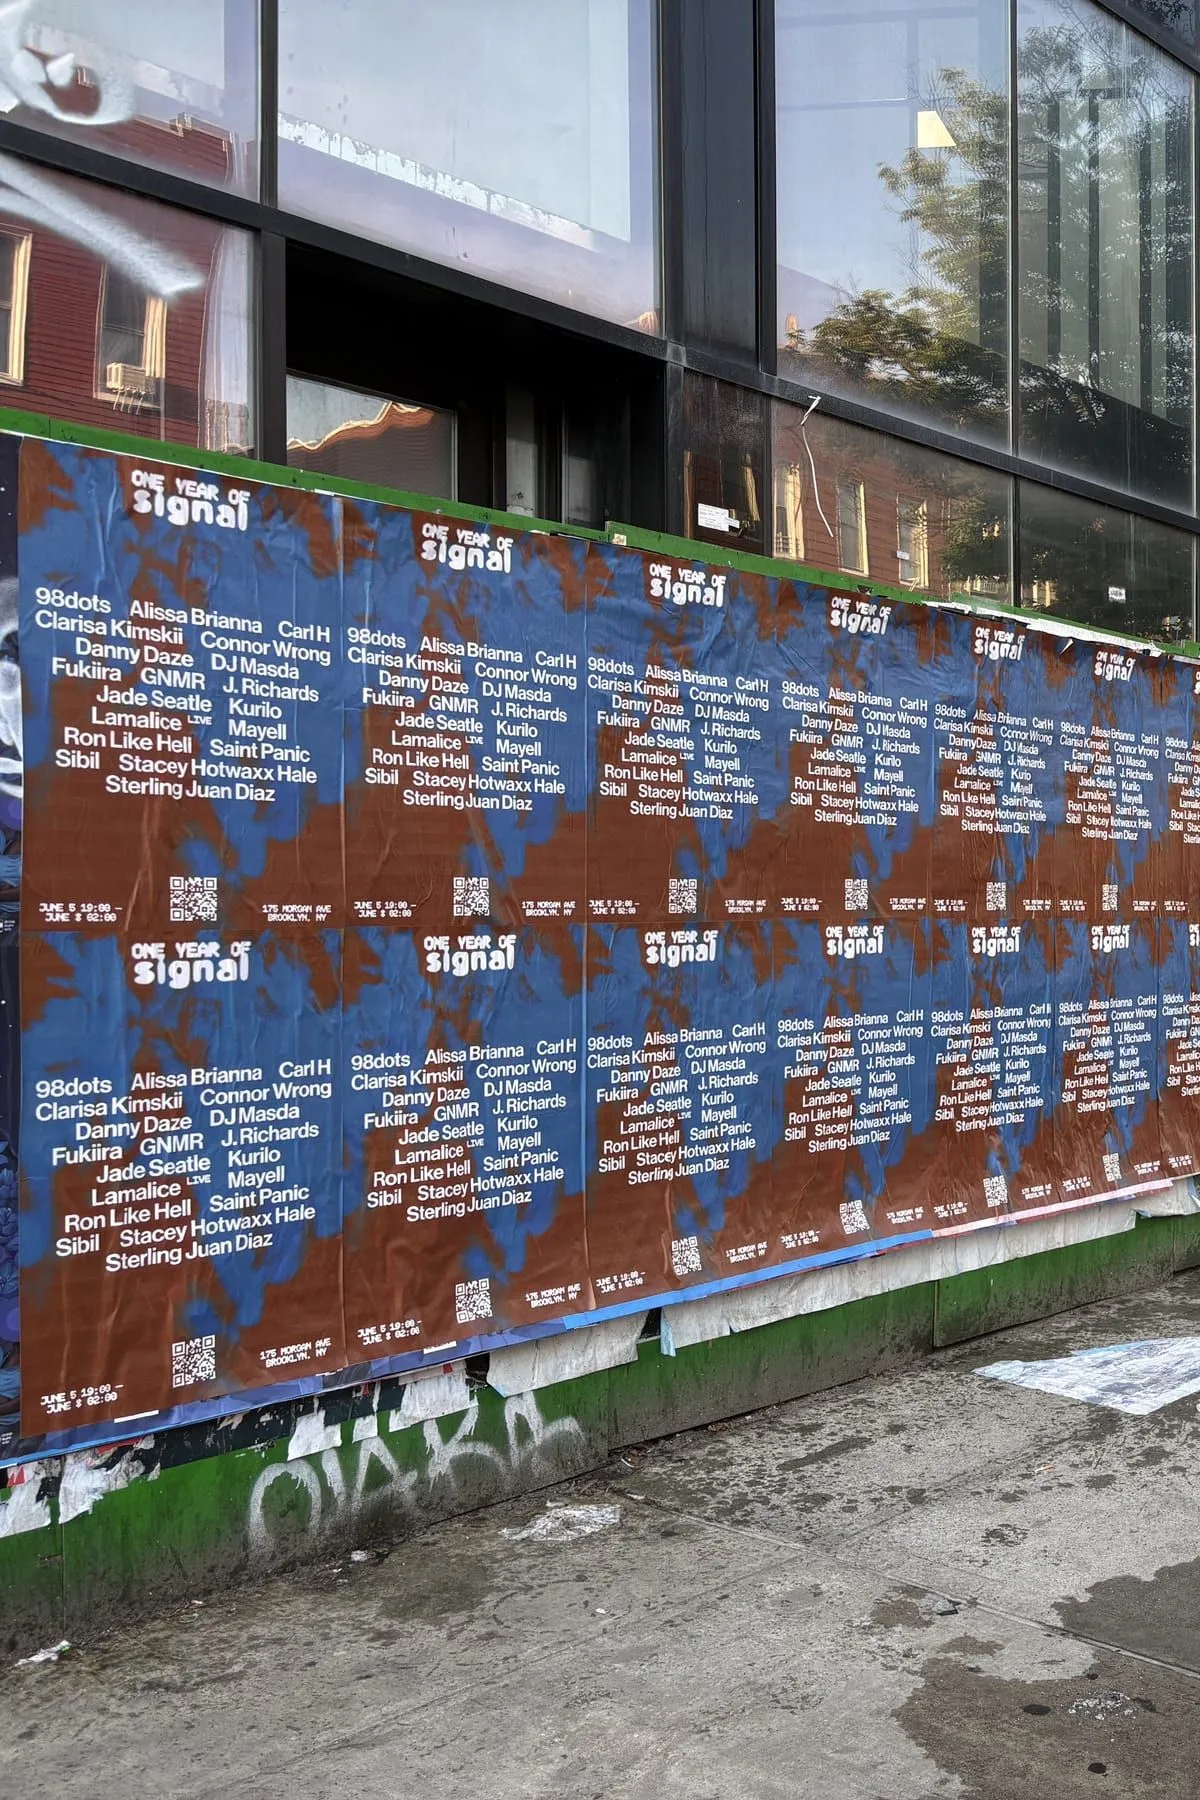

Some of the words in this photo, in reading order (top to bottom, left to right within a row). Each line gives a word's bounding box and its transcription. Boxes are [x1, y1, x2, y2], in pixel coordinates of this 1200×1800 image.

[131, 470, 165, 491] ONE
[175, 477, 219, 501] YEAR
[228, 489, 250, 505] OF
[133, 489, 248, 531] signal
[422, 522, 449, 540] ONE
[456, 528, 490, 548] YEAR
[496, 536, 513, 550] OF
[421, 539, 511, 573] signal
[35, 587, 111, 613] 98dots
[130, 600, 188, 624] Alissa
[191, 608, 262, 633] Brianna
[278, 621, 314, 640] Carl
[317, 626, 330, 643] H
[830, 608, 888, 635] signal
[831, 596, 849, 610] ONE
[855, 600, 876, 614] YEAR
[879, 606, 892, 617] OF
[35, 610, 107, 635] Clarisa
[111, 619, 183, 644] Kimskii
[201, 631, 271, 655] Connor
[272, 640, 330, 666] Wrong
[76, 637, 140, 664] Danny
[144, 645, 194, 667] Daze
[211, 653, 237, 672] DJ
[241, 657, 299, 679] Masda
[348, 647, 403, 668] Clarisa
[406, 653, 461, 674] Kimskii
[475, 662, 529, 681] Connor
[531, 668, 577, 690] Wrong
[52, 657, 121, 681] Fukiira
[140, 667, 205, 690] GNMR
[223, 676, 238, 693] J.
[242, 678, 319, 702] Richards
[97, 685, 148, 706] Jade
[151, 690, 212, 712] Seatle
[229, 698, 282, 719] Kurilo
[612, 694, 652, 714] Danny
[654, 699, 684, 715] Daze
[695, 704, 710, 718] DJ
[712, 706, 749, 722] Masda
[92, 706, 182, 731] Lamalice
[188, 715, 212, 725] LIVE
[229, 719, 286, 741] Mayell
[64, 727, 106, 747] Ron
[110, 731, 153, 750] Like
[157, 734, 192, 753] Hell
[210, 739, 258, 758] Saint
[261, 743, 310, 762] Panic
[56, 749, 99, 769] Sibil
[119, 754, 188, 778] Stacey
[191, 759, 274, 780] Hotwaxx
[278, 765, 317, 783] Hale
[106, 775, 182, 799] Sterling
[186, 780, 232, 799] Juan
[236, 783, 275, 801] Diaz
[795, 777, 815, 790] Ron
[817, 779, 837, 792] Like
[839, 781, 856, 793] Hell
[864, 782, 889, 796] Saint
[891, 784, 915, 797] Panic
[39, 903, 64, 912] JUNE
[68, 903, 76, 912] 5
[80, 903, 111, 912] 19:00
[45, 912, 70, 922] JUNE
[74, 912, 82, 922] 8
[86, 912, 117, 922] 02:00
[262, 904, 279, 913] 175
[281, 905, 312, 913] MORGAN
[315, 905, 332, 913] AVE
[315, 913, 327, 922] NY
[131, 942, 165, 959] ONE
[175, 941, 220, 958] YEAR
[230, 941, 251, 957] OF
[423, 935, 449, 951] ONE
[457, 935, 491, 950] YEAR
[498, 934, 516, 949] OF
[645, 931, 665, 944] ONE
[671, 930, 698, 944] YEAR
[703, 929, 718, 942] OF
[646, 939, 716, 967] signal
[134, 953, 249, 989] signal
[426, 944, 514, 977] signal
[947, 1039, 973, 1049] Danny
[974, 1036, 993, 1046] Daze
[1001, 1032, 1011, 1044] DJ
[1011, 1031, 1037, 1043] Masda
[36, 1077, 112, 1098] 98dots
[131, 1072, 187, 1090] Alissa
[191, 1067, 262, 1085] Brianna
[279, 1060, 314, 1078] Carl
[318, 1059, 330, 1075] H
[364, 1110, 418, 1129] Fukiira
[434, 1102, 479, 1121] GNMR
[493, 1100, 504, 1114] J.
[507, 1094, 566, 1113] Richards
[599, 1156, 625, 1172] Sibil
[637, 1151, 676, 1166] Stacey
[679, 1142, 729, 1159] Hotwaxx
[731, 1136, 755, 1151] Hale
[809, 1137, 847, 1152] Sterling
[848, 1134, 870, 1146] Juan
[871, 1131, 890, 1142] Diaz
[106, 1248, 182, 1272] Sterling
[185, 1241, 232, 1259] Juan
[236, 1233, 273, 1251] Diaz
